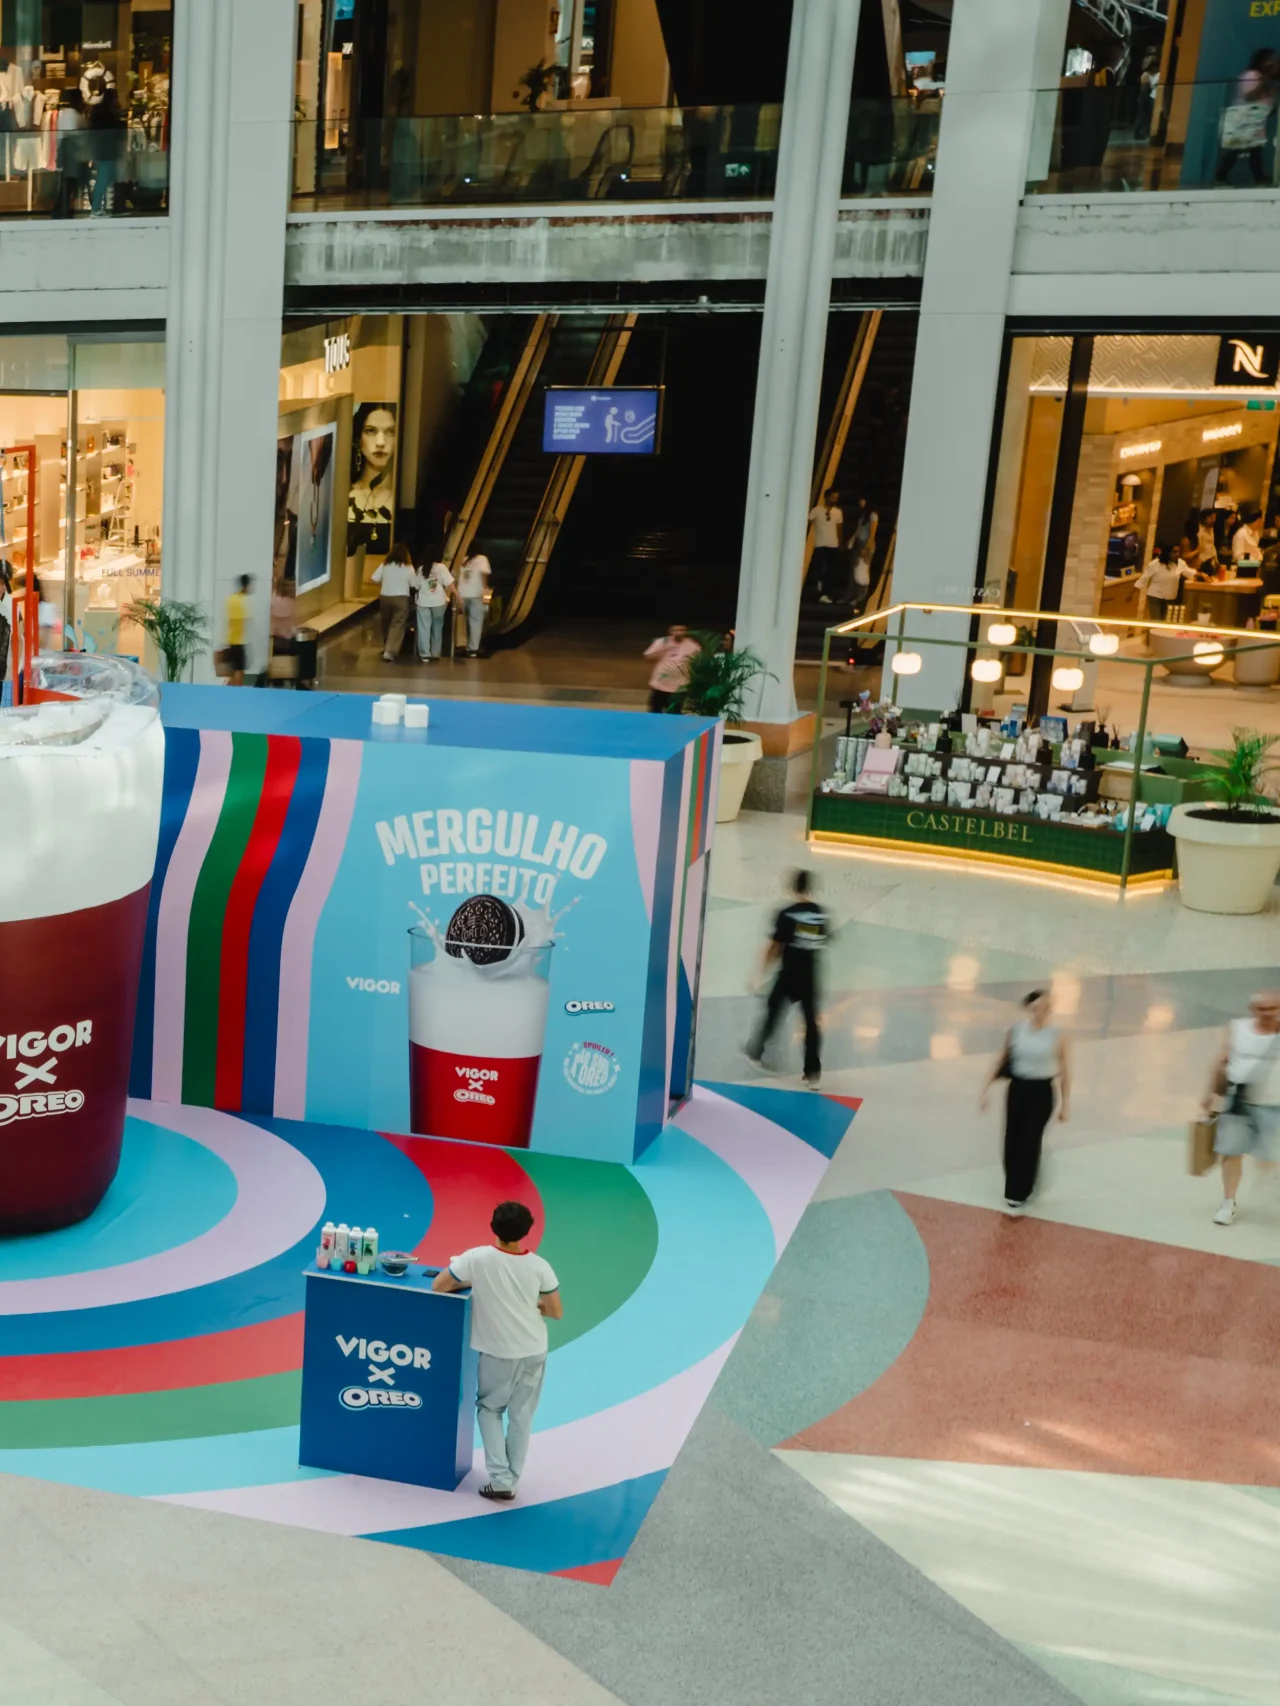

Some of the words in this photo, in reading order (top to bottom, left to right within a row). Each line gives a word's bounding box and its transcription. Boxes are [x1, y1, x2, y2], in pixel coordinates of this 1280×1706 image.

[101, 568, 123, 577] FULL
[126, 568, 161, 577] SUMME
[906, 810, 1034, 843] CASTELBEL
[375, 808, 608, 880] MERGULHO
[420, 862, 558, 905] PERFEITO
[345, 976, 401, 995] VIGOR
[565, 1000, 615, 1014] OREO
[455, 1066, 499, 1081] VIGOR
[454, 1090, 495, 1105] OREO
[335, 1334, 431, 1370] VIGOR
[341, 1387, 422, 1409] OREO
